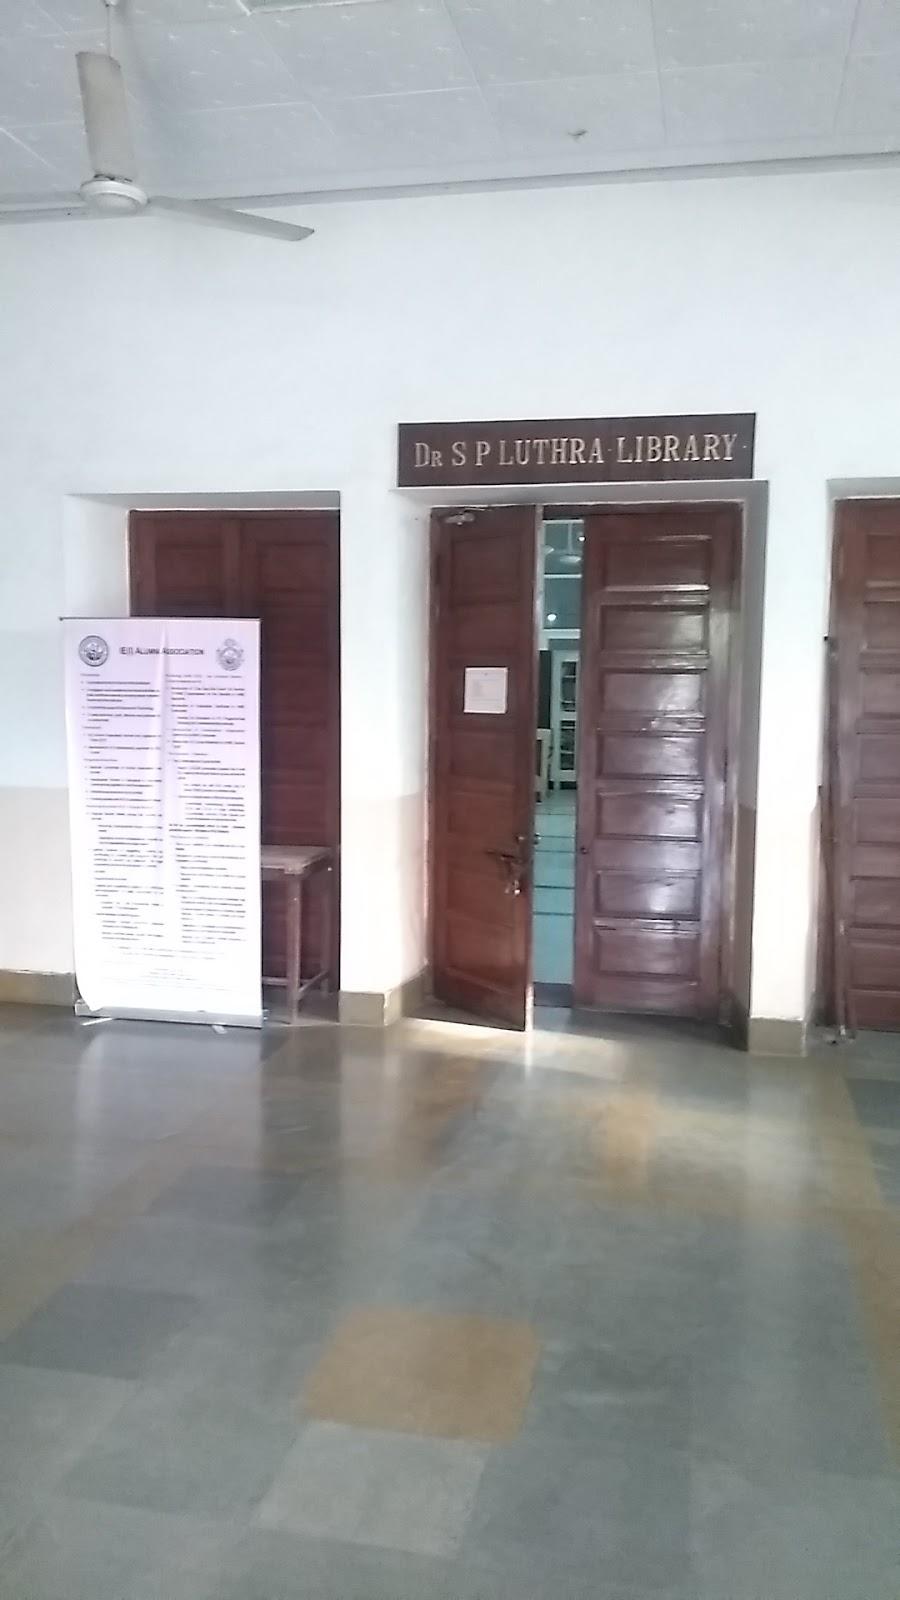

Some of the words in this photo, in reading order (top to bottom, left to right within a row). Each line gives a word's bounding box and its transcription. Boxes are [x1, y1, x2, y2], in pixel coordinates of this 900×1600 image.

[451, 441, 467, 467] S
[475, 440, 490, 467] P
[499, 437, 604, 466] LUTHRA
[617, 433, 738, 464] LIBRARY
